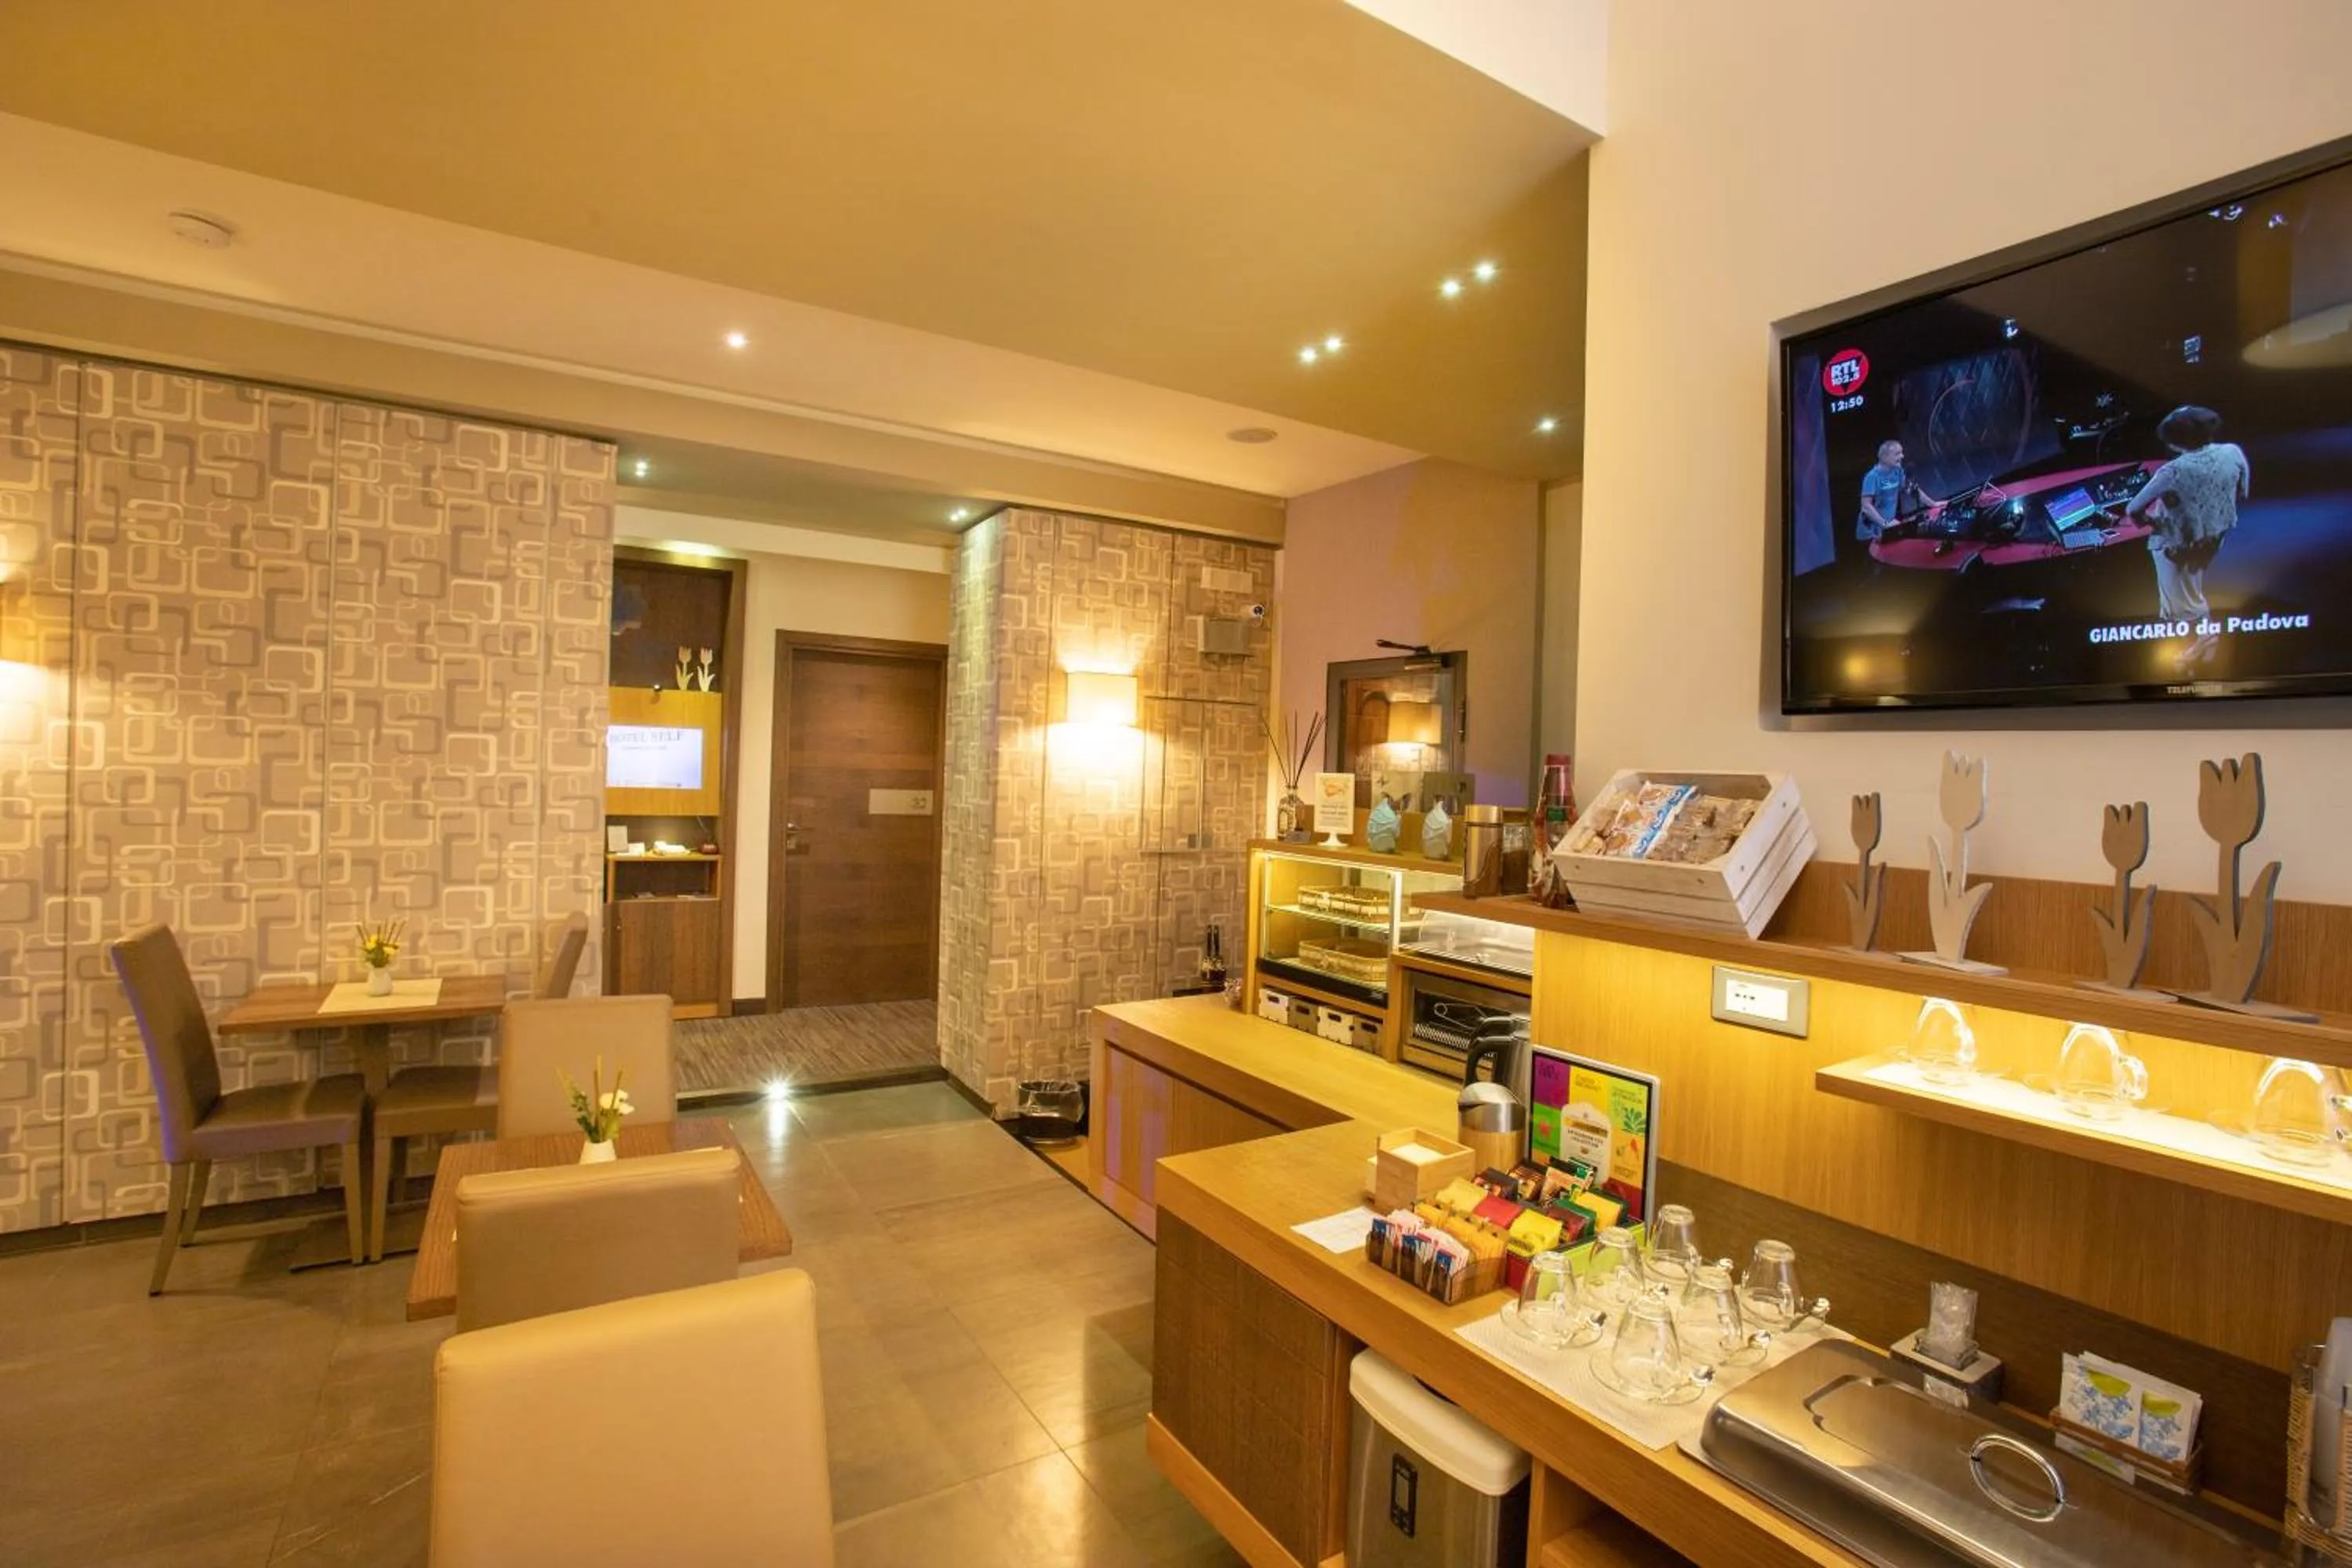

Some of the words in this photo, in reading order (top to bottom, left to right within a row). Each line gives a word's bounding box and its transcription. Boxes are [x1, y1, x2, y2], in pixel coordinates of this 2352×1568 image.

[1831, 359, 1860, 379] RTL
[1831, 394, 1864, 413] 12:50
[2089, 621, 2190, 643] GIANCARLO
[2195, 618, 2221, 635] da
[2227, 612, 2310, 633] Padova
